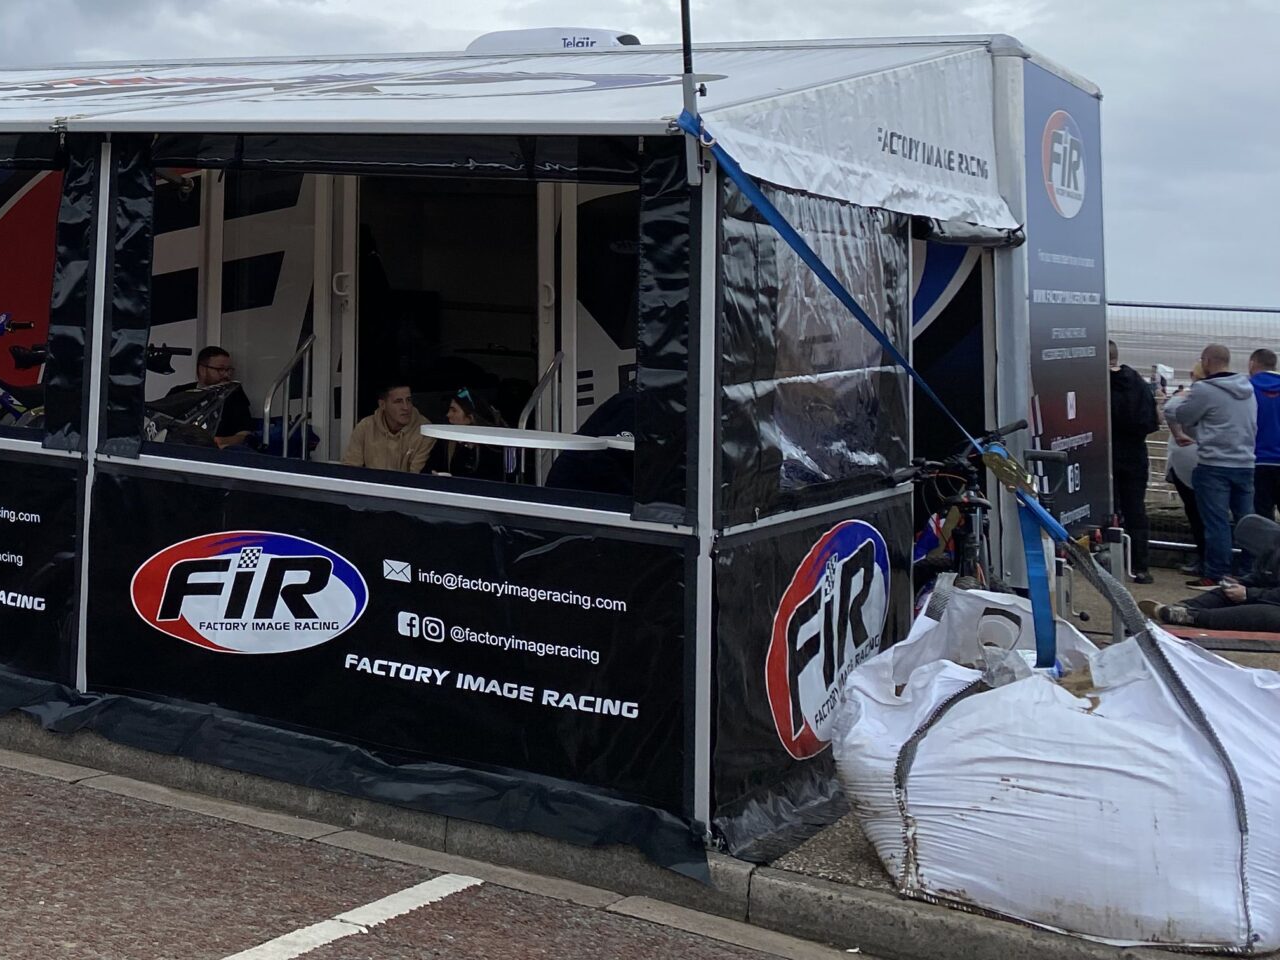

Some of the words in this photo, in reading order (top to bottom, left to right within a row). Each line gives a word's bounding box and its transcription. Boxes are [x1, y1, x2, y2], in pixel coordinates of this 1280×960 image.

[418, 569, 628, 612] info@factoryimageracing.com
[199, 621, 248, 631] FACTORY
[252, 621, 290, 631] IMAGE
[294, 621, 339, 631] RACING
[450, 625, 600, 665] @factoryimageracing
[344, 653, 450, 686] FACTORY
[456, 673, 534, 703] IMAGE
[542, 690, 639, 719] RACING
[814, 687, 839, 730] FACTORY
